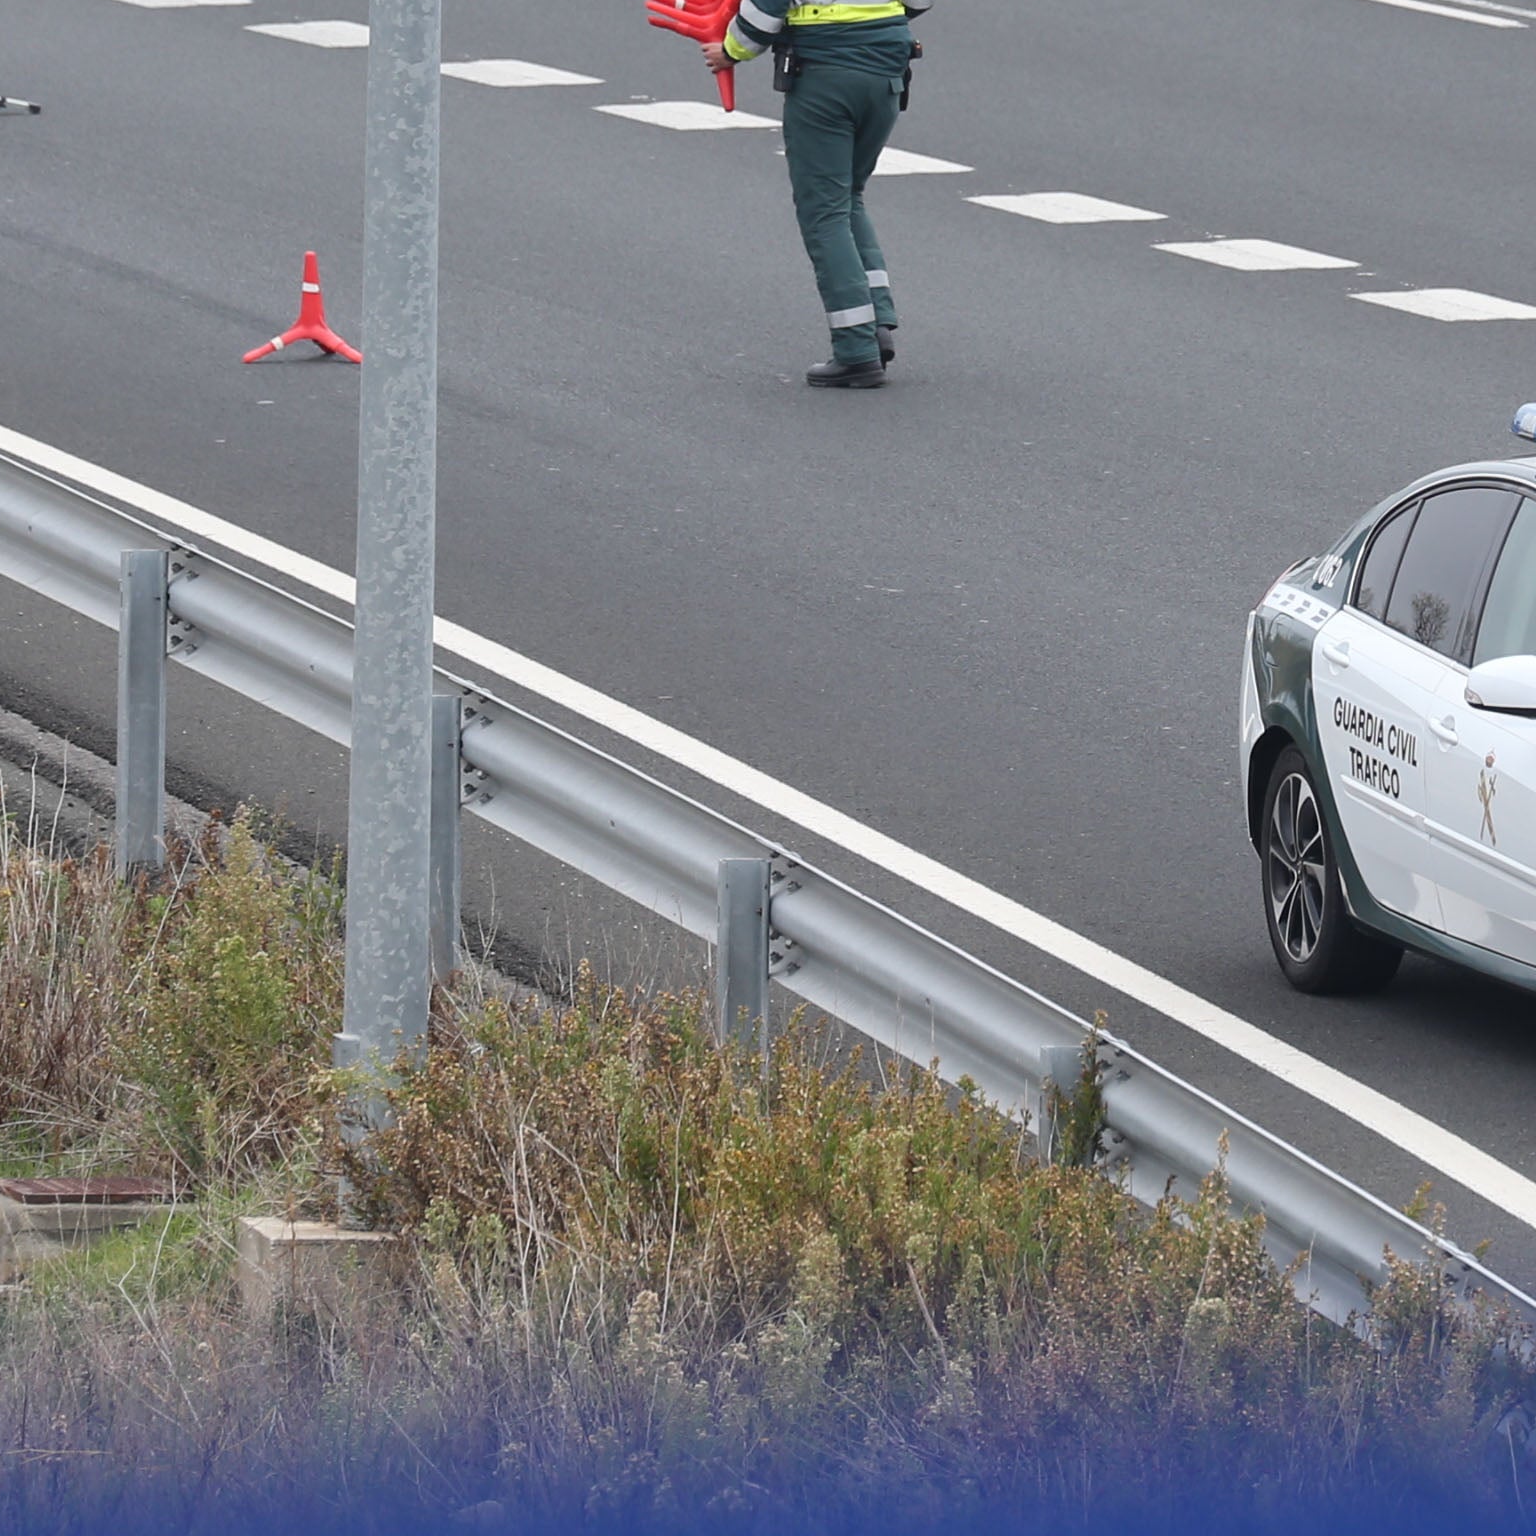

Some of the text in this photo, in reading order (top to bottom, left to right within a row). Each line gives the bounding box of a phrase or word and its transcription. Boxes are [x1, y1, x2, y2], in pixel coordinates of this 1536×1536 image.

[1334, 696, 1417, 767] GUARDIA CIVIL
[1349, 746, 1400, 799] TRAFICO
